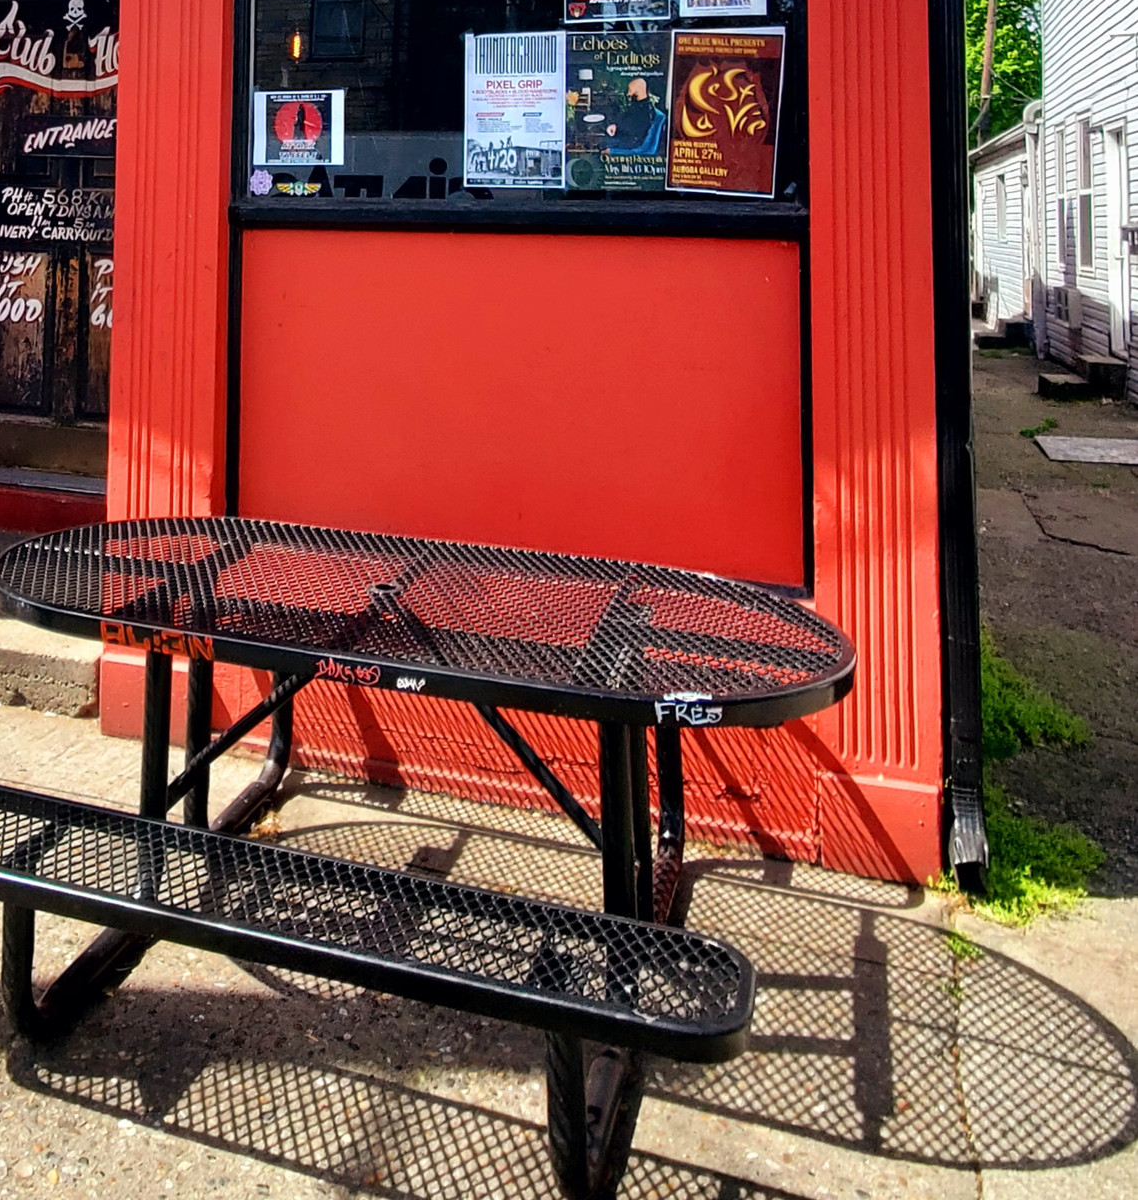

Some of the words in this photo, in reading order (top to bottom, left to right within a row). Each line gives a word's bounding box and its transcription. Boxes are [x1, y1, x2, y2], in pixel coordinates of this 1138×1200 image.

[572, 35, 629, 51] Echoes
[474, 35, 557, 75] THUNDERGROUND
[606, 51, 660, 68] Endings
[486, 80, 516, 90] PIXEL
[517, 79, 543, 90] GRIP
[23, 118, 117, 153] ENTRANCE
[673, 147, 700, 159] APRIL
[7, 202, 45, 216] OPEN
[48, 204, 58, 217] 7
[56, 204, 91, 219] DAYS
